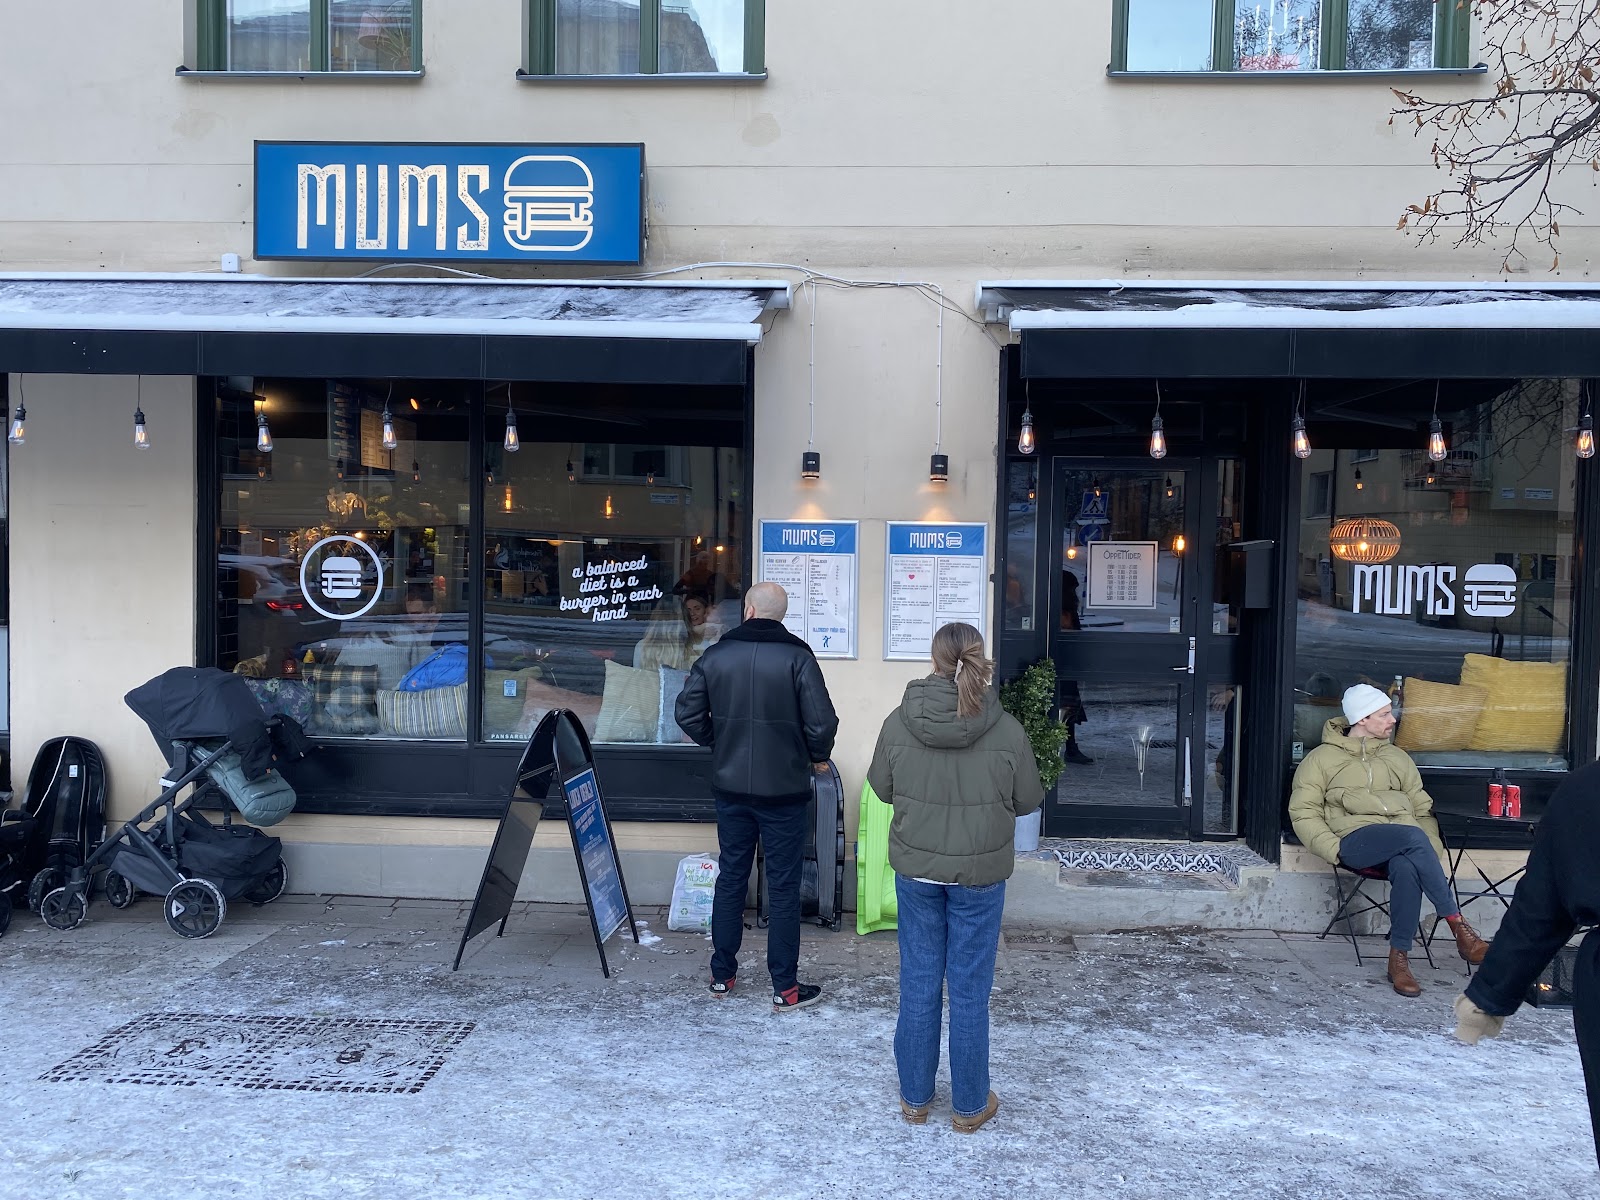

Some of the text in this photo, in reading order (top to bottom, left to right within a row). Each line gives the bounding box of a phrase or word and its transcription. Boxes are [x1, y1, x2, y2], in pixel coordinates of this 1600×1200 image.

[297, 163, 490, 251] MUMS
[782, 529, 817, 546] MUMS
[909, 532, 945, 549] MUMS
[572, 555, 648, 578] a balanced
[579, 575, 639, 592] diet is a
[1352, 564, 1457, 616] MUMS
[560, 584, 663, 613] burger in each
[592, 604, 628, 622] hand
[700, 862, 713, 870] ICA
